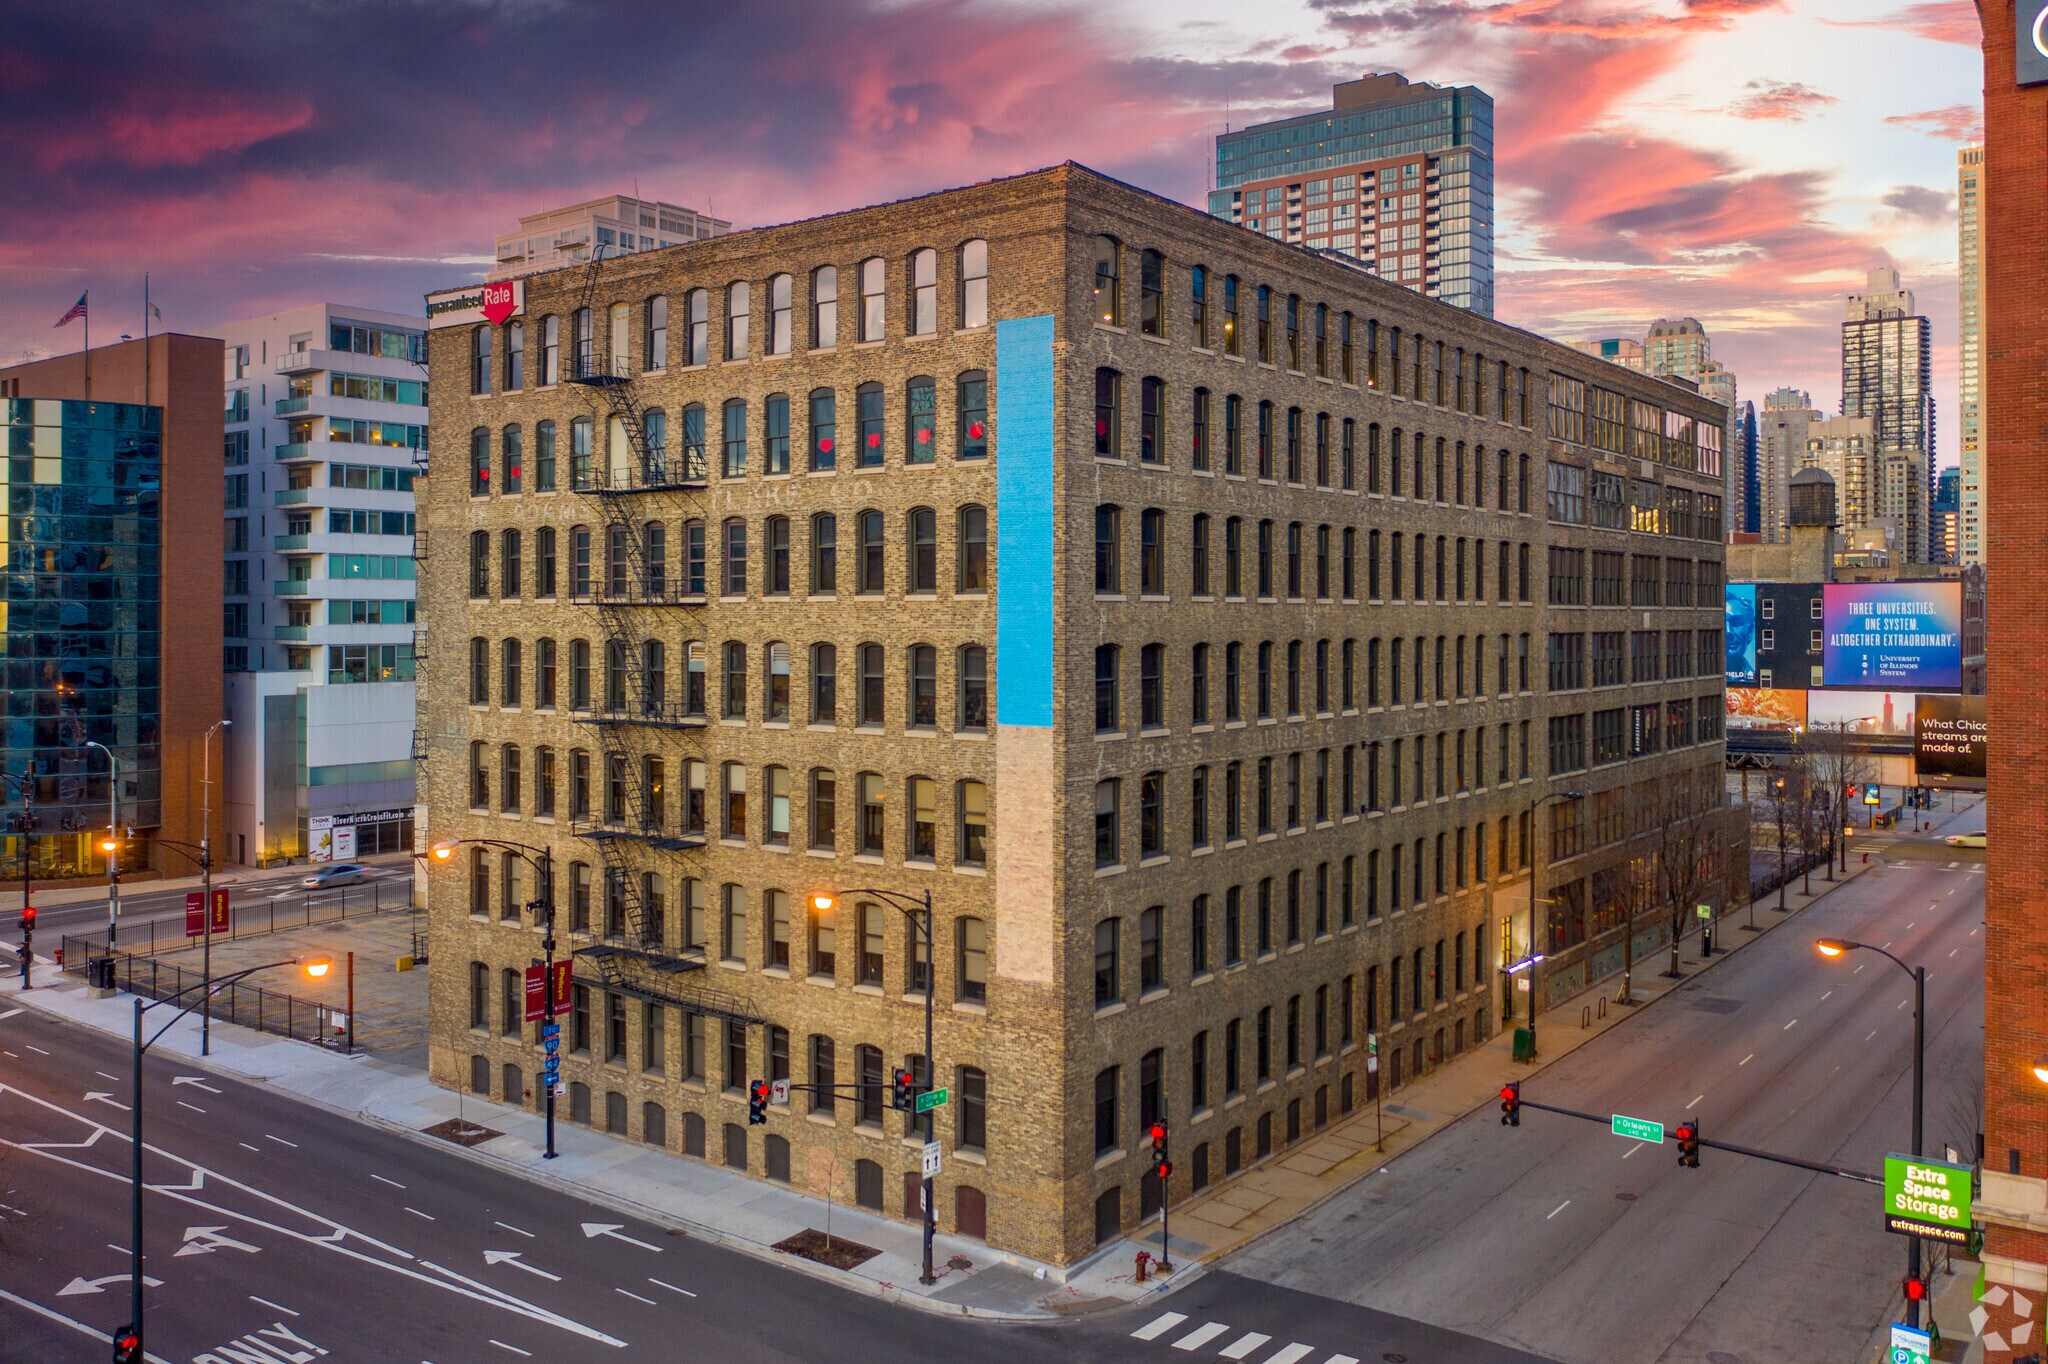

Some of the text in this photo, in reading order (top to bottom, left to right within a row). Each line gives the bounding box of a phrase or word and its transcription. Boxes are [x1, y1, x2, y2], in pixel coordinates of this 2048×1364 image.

[484, 287, 511, 306] Rate
[1848, 602, 1937, 615] THREE UNIVERSITIES.
[1864, 618, 1919, 631] ONE SYSTEM.
[1830, 633, 1880, 647] ALTOGETHER
[1922, 718, 1987, 731] What Chica
[1922, 731, 1987, 742] streams are
[1922, 742, 1971, 754] made of.
[311, 817, 330, 825] THINK
[547, 1041, 558, 1051] 90
[547, 1059, 558, 1069] 94
[1622, 1119, 1651, 1132] Orleans
[1906, 1165, 1947, 1186] Extra
[1903, 1179, 1951, 1201] Space
[1895, 1193, 1959, 1220] Storage
[1890, 1219, 1966, 1241] extraspace.com
